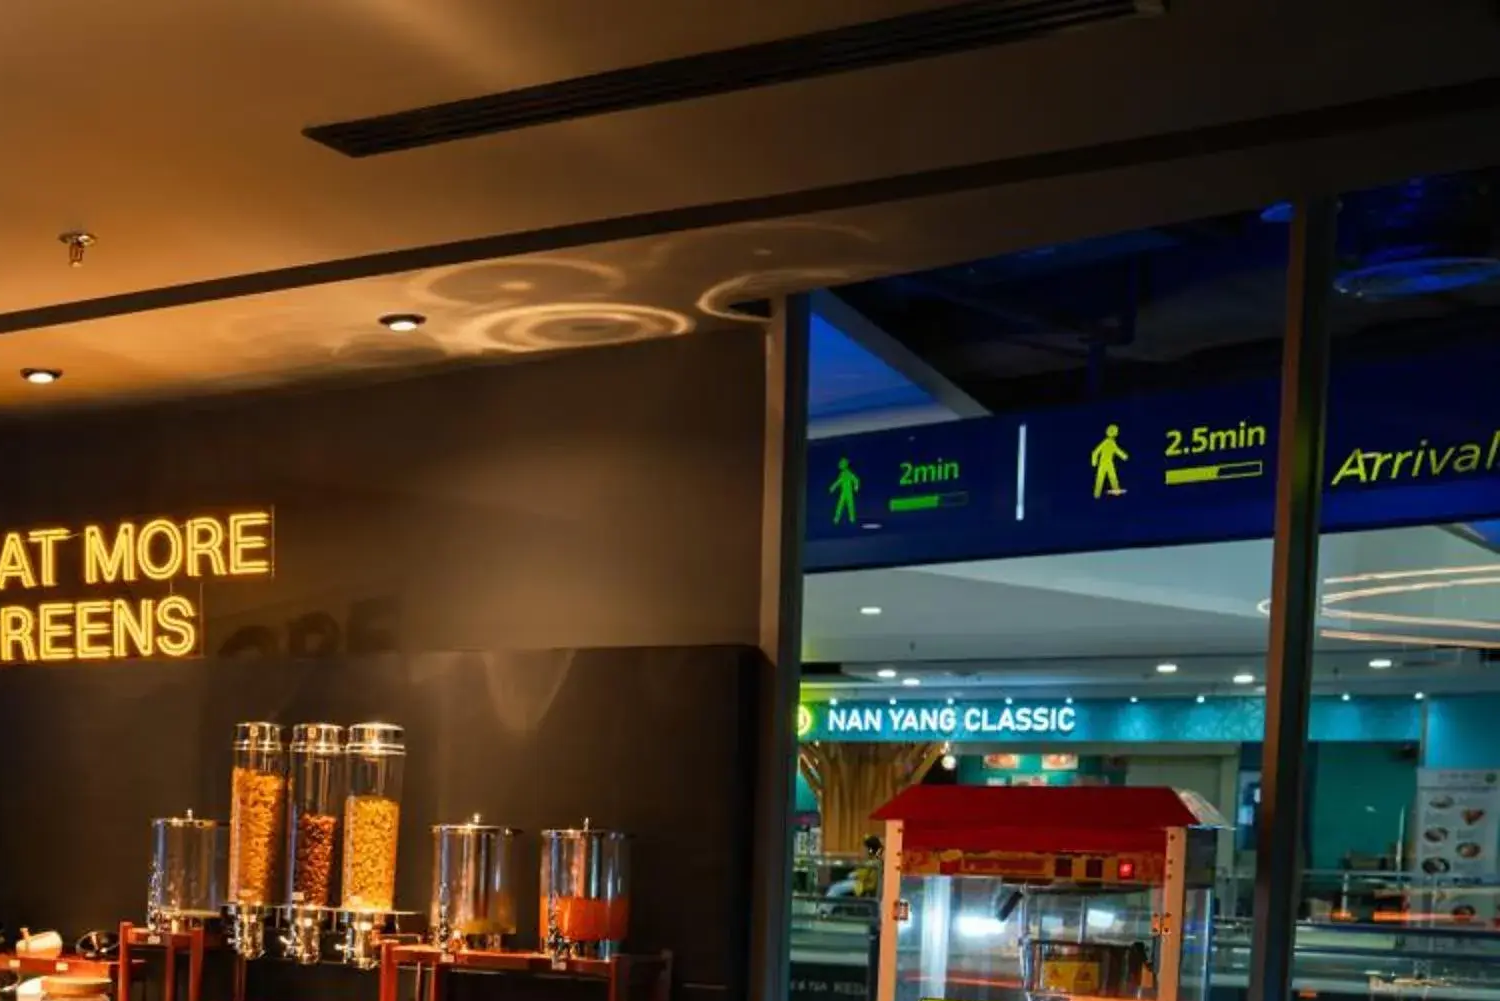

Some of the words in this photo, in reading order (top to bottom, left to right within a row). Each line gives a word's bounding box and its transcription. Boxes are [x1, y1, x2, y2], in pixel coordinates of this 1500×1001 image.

[1165, 421, 1265, 456] 2.5min
[899, 457, 959, 486] 2min
[85, 512, 270, 584] MORE
[828, 708, 882, 731] NAN
[889, 708, 956, 731] YANG
[964, 707, 1076, 731] CLASSIC
